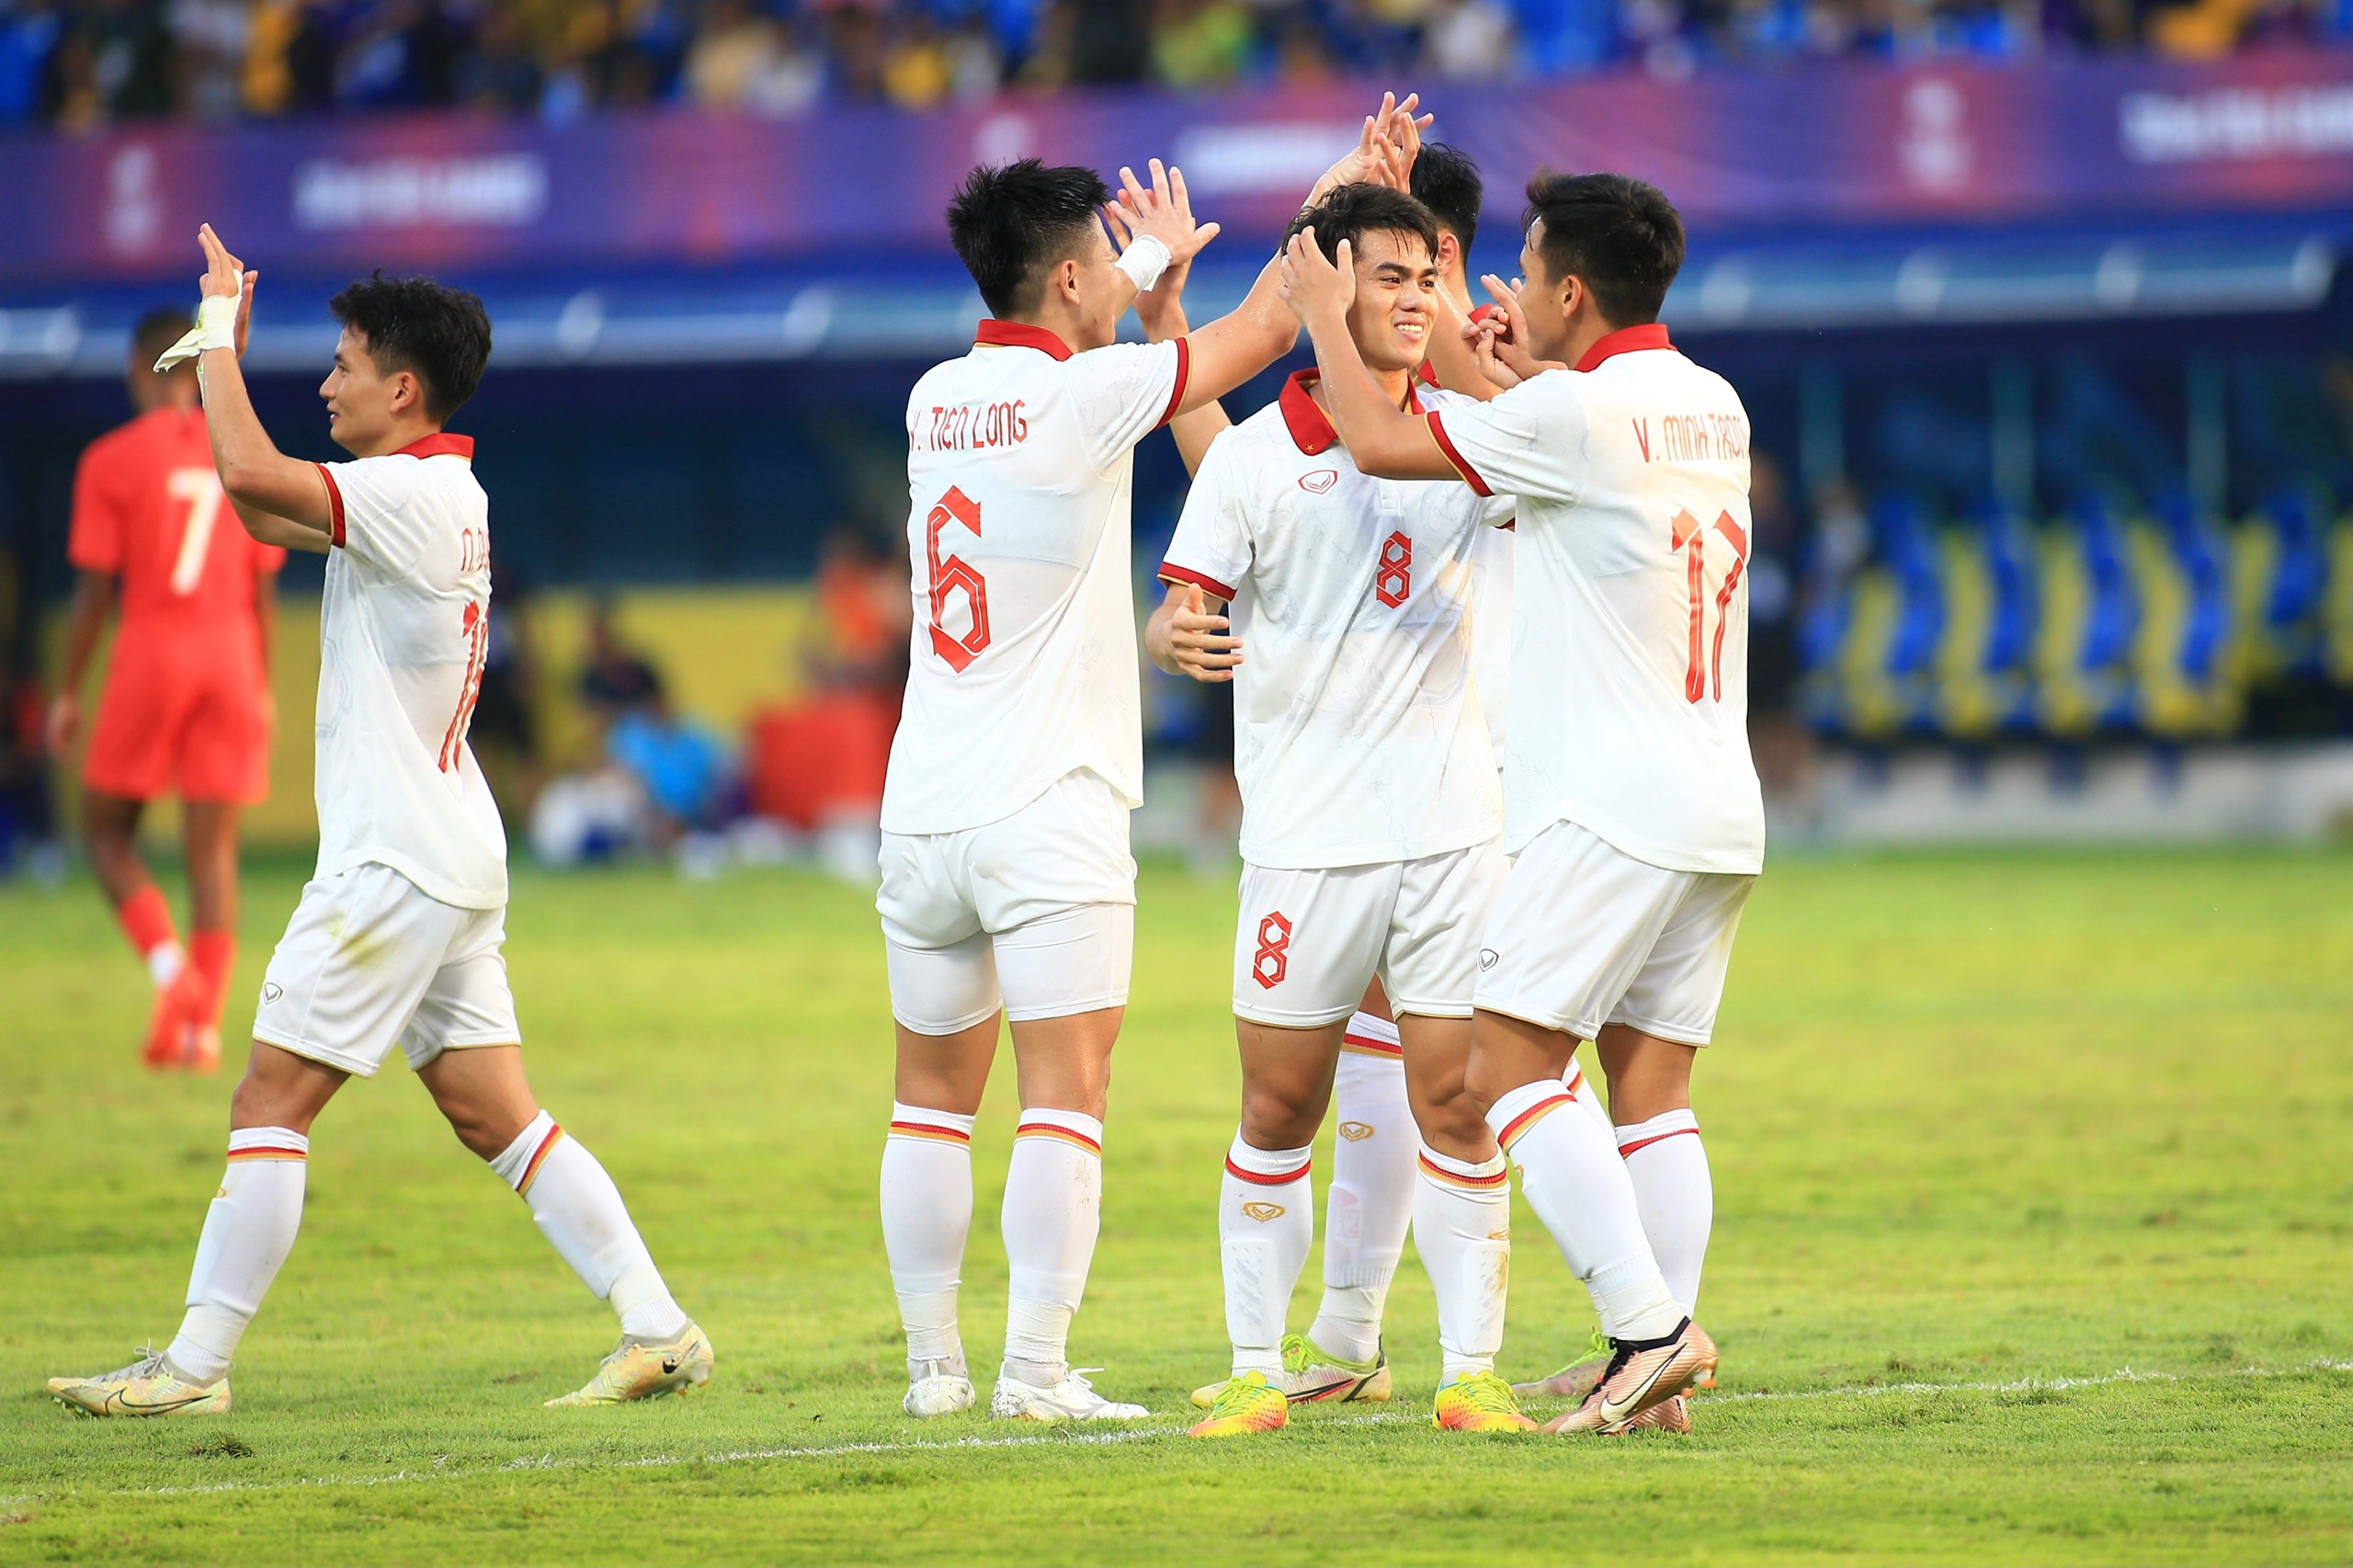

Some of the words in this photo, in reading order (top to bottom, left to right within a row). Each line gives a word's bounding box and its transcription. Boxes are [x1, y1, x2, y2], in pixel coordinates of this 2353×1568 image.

[931, 406, 969, 451] TIEN
[972, 399, 1028, 448] LONG
[1632, 417, 1660, 462] V.
[1663, 415, 1710, 461] MINH
[166, 468, 222, 595] 7
[1377, 530, 1412, 609] 8
[926, 484, 991, 674] 6
[1253, 911, 1292, 990] 8
